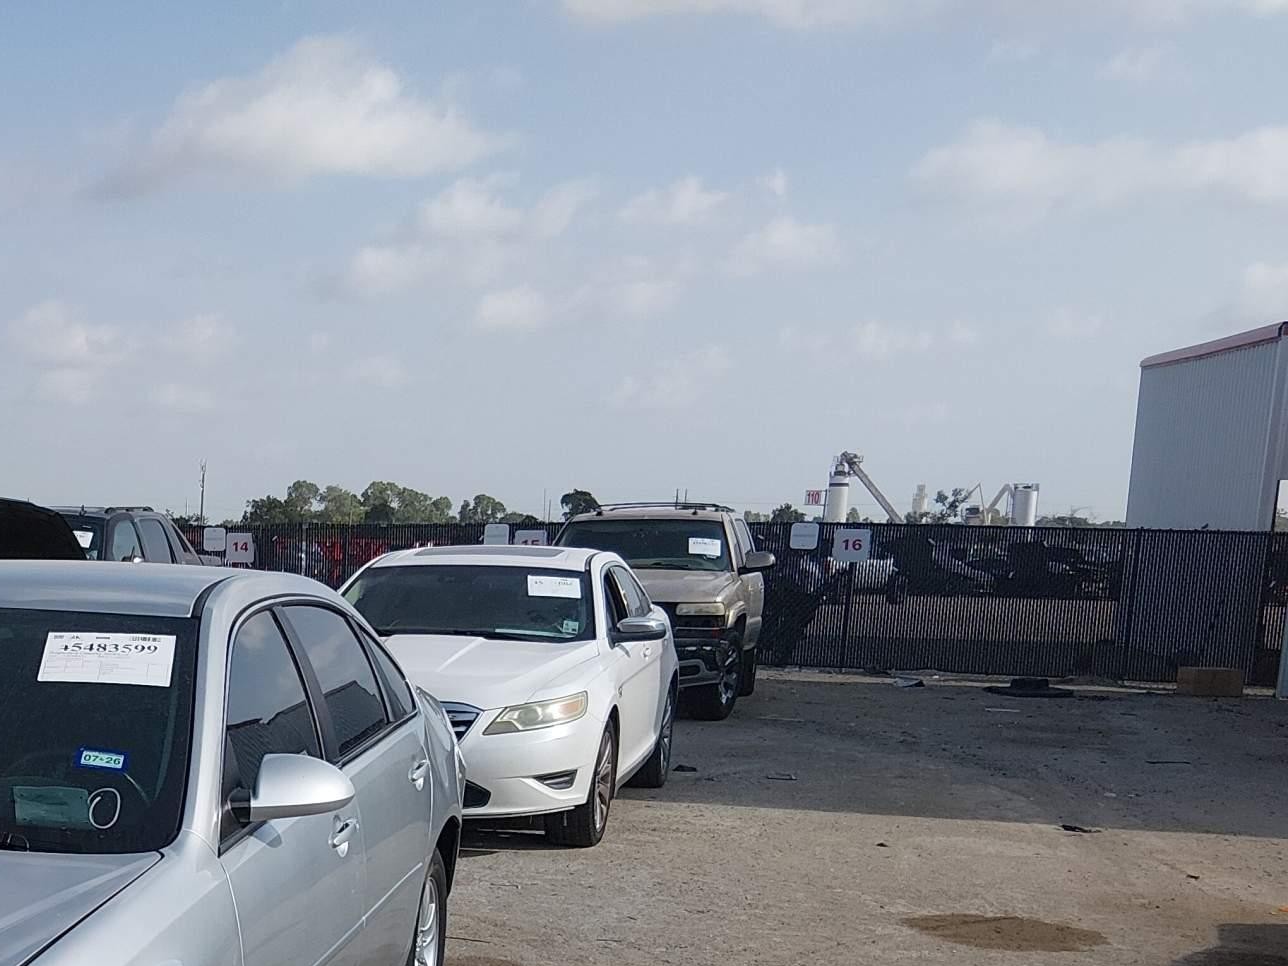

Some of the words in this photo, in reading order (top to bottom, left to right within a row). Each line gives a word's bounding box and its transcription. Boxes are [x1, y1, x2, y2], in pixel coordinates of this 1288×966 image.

[807, 491, 820, 505] 110
[232, 542, 249, 553] 14
[842, 539, 863, 552] 16
[59, 642, 159, 655] 45483599
